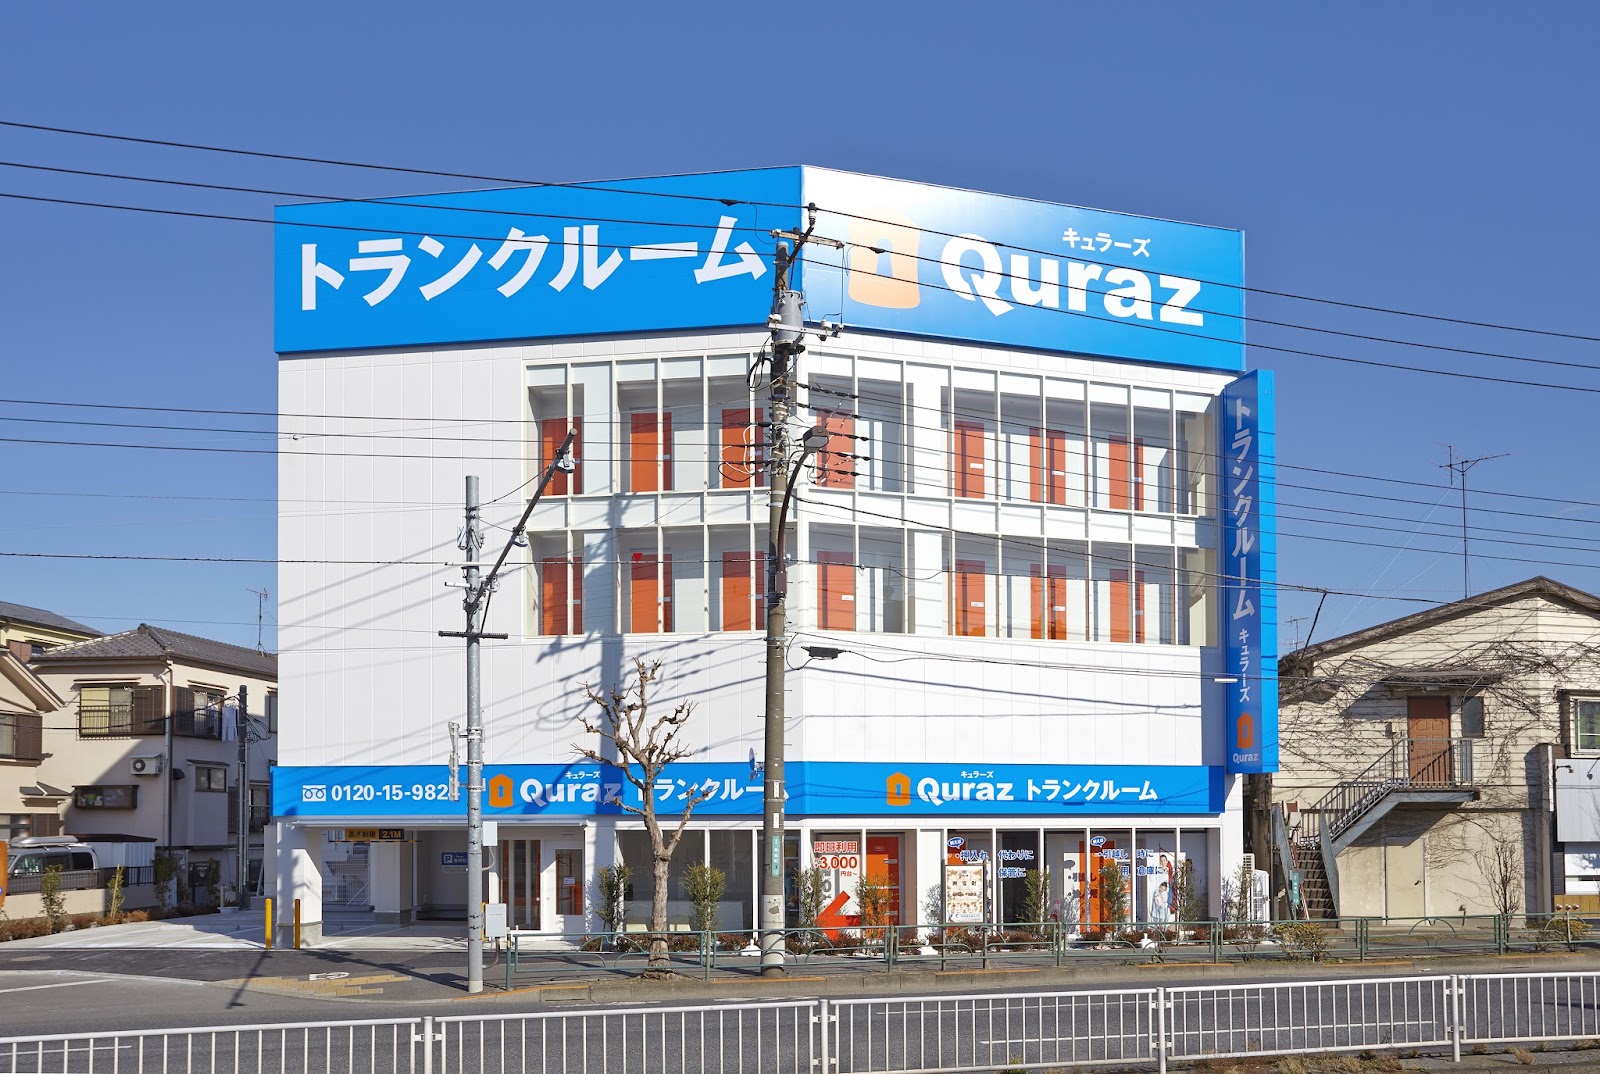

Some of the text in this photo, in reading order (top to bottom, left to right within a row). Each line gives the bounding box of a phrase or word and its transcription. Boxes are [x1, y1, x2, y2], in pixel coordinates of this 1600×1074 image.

[1062, 228, 1151, 258] キュラーズ
[302, 215, 767, 311] トランクルーム
[940, 232, 1204, 327] Quraz
[1231, 398, 1256, 621] トランクルーム
[1238, 629, 1251, 703] キュラーズ
[1233, 752, 1259, 764] Quraz
[565, 770, 600, 780] キュラーズ
[961, 770, 994, 779] キュラーズ
[519, 778, 622, 807] Quraz
[637, 778, 790, 802] トランクルー
[917, 777, 1158, 806] Quraz トランクルーム
[814, 841, 858, 853] 即日利用
[819, 856, 858, 871] 3,000
